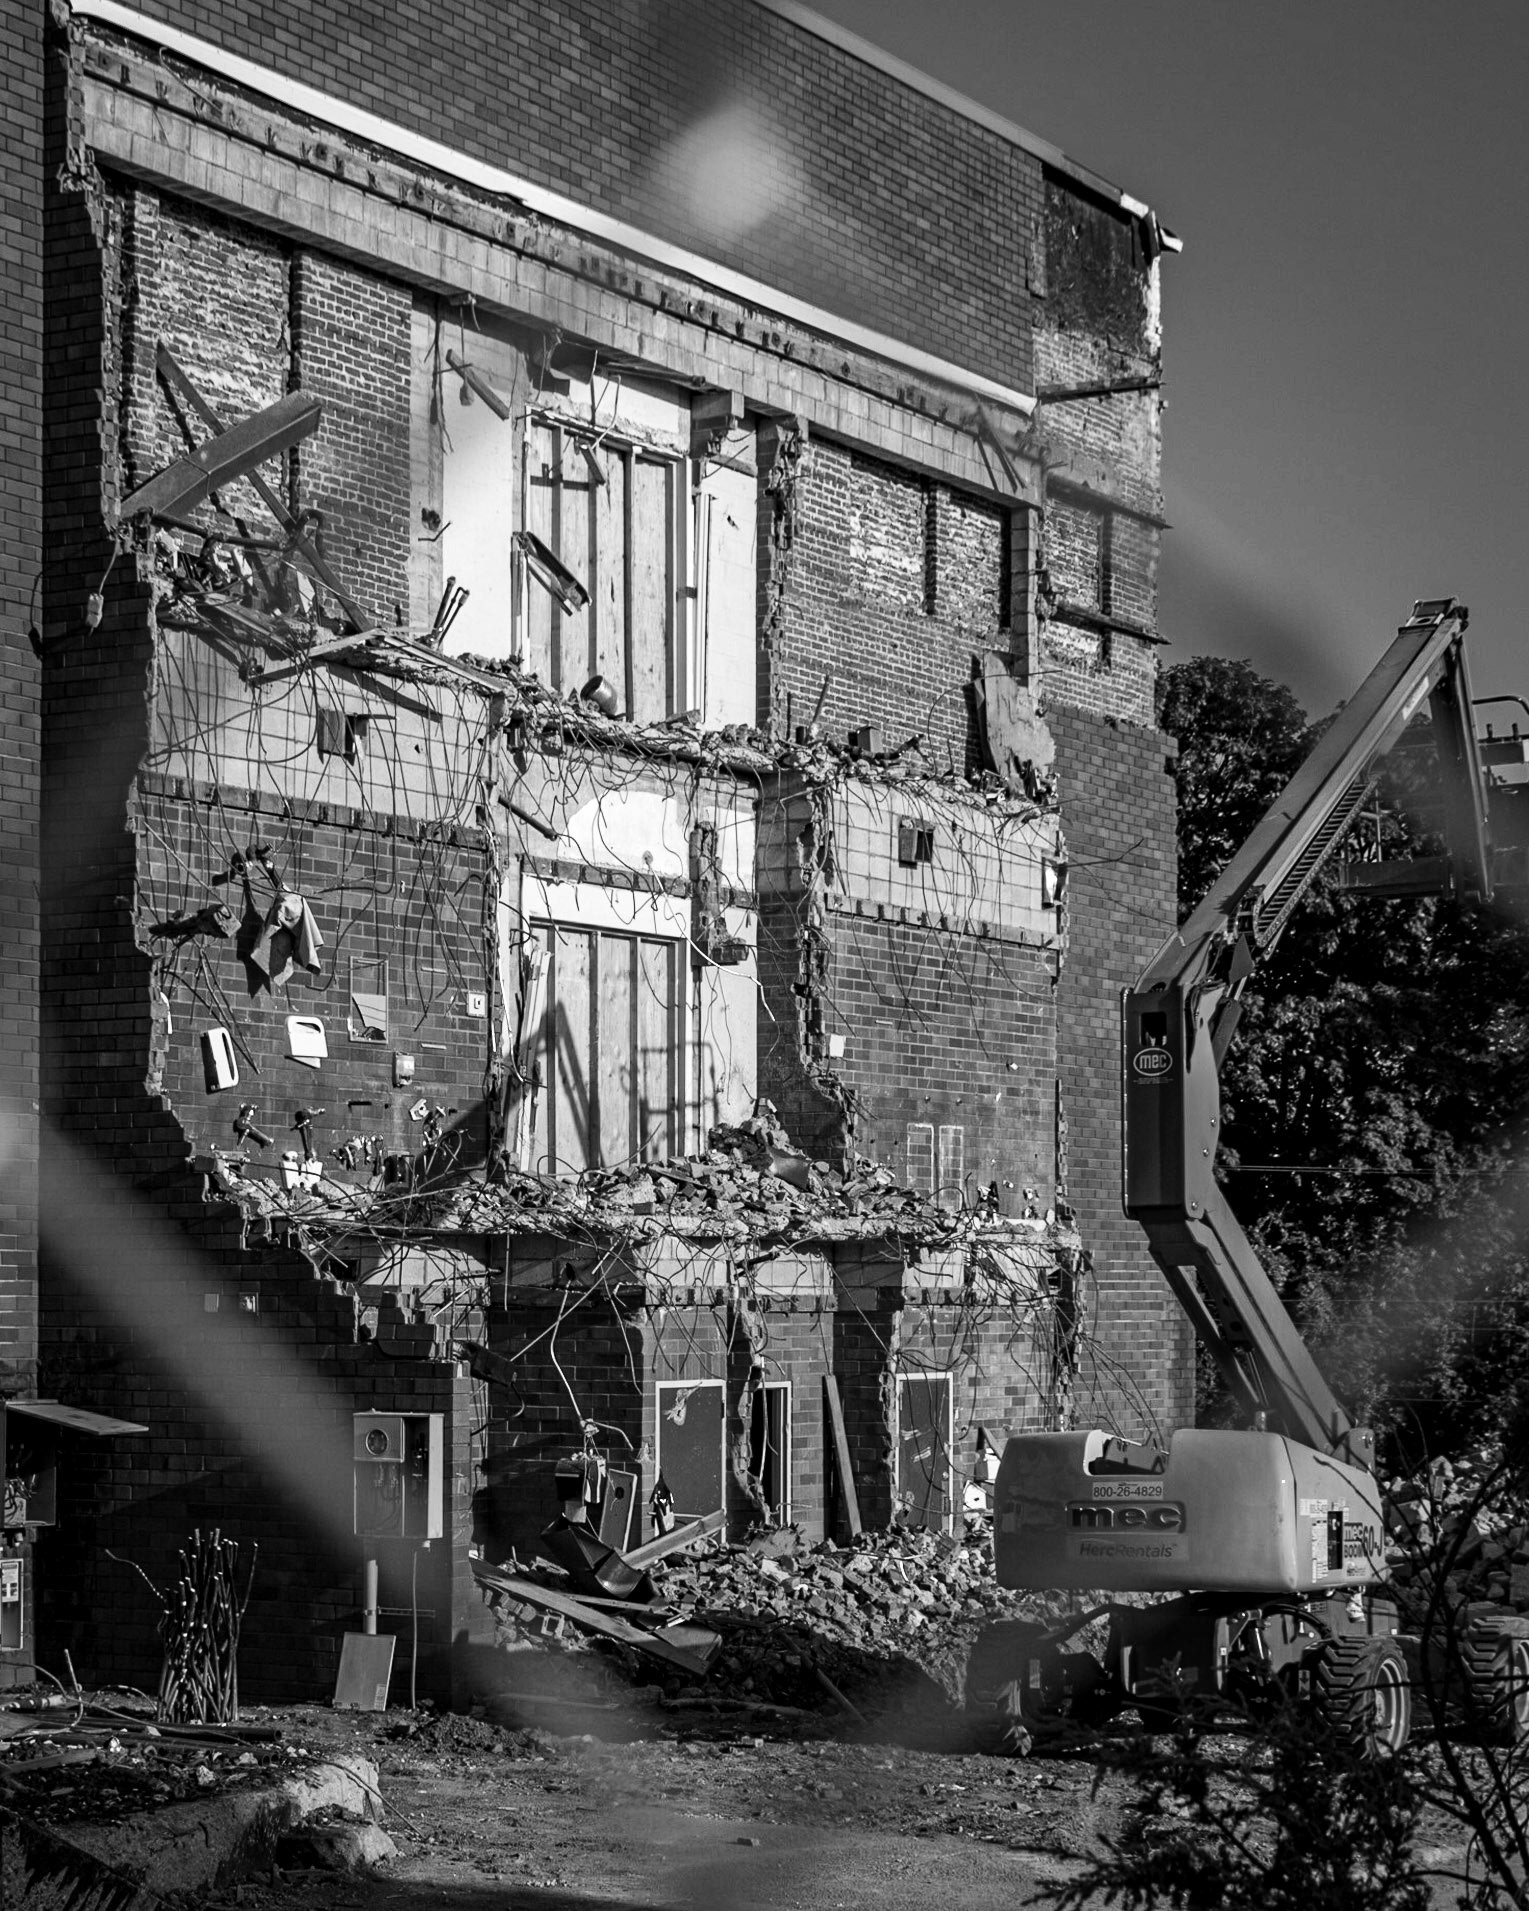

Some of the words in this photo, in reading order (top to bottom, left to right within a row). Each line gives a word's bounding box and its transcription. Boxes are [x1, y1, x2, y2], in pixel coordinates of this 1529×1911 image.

[1139, 1054, 1167, 1069] mec
[1093, 1486, 1162, 1497] 800-26-4829
[1072, 1507, 1181, 1529] mec
